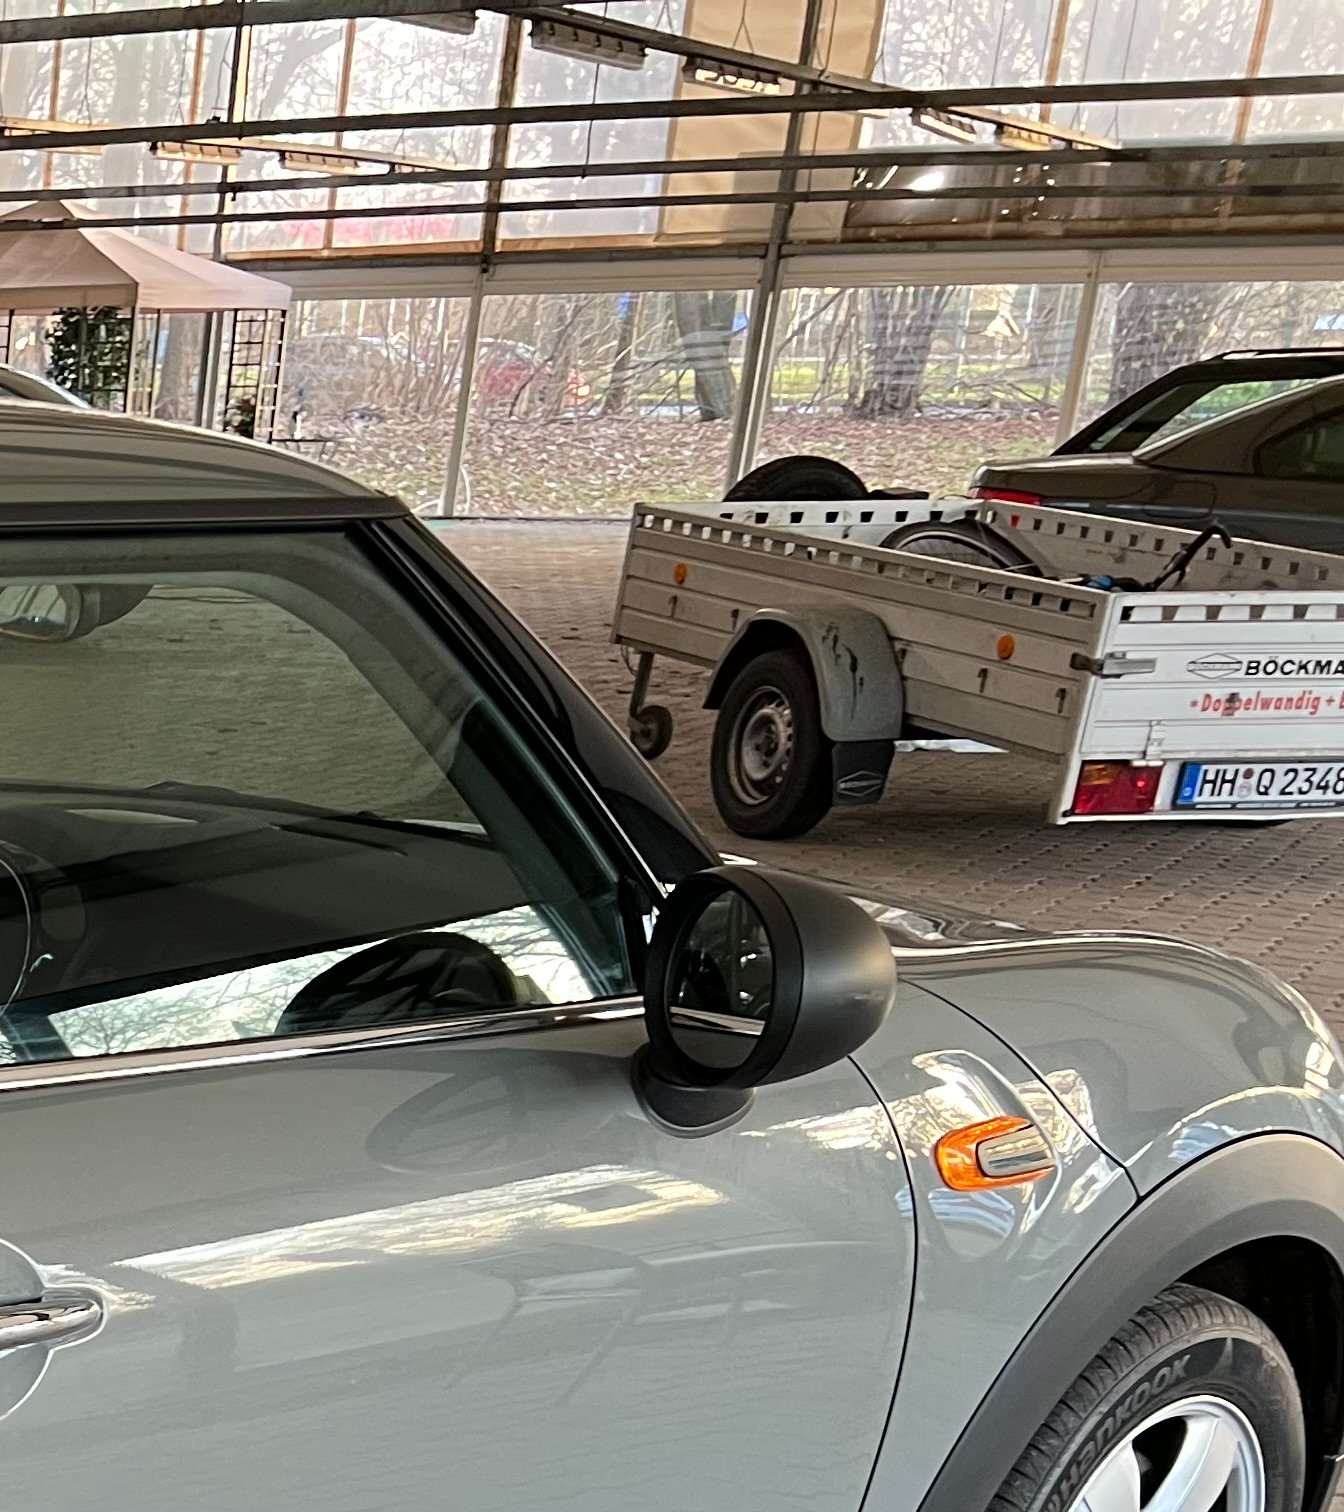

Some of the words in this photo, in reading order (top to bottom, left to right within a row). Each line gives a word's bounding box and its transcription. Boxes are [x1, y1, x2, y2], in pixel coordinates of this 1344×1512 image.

[1198, 768, 1239, 797] HH
[1256, 768, 1276, 796] Q
[1279, 767, 1344, 796] 2348
